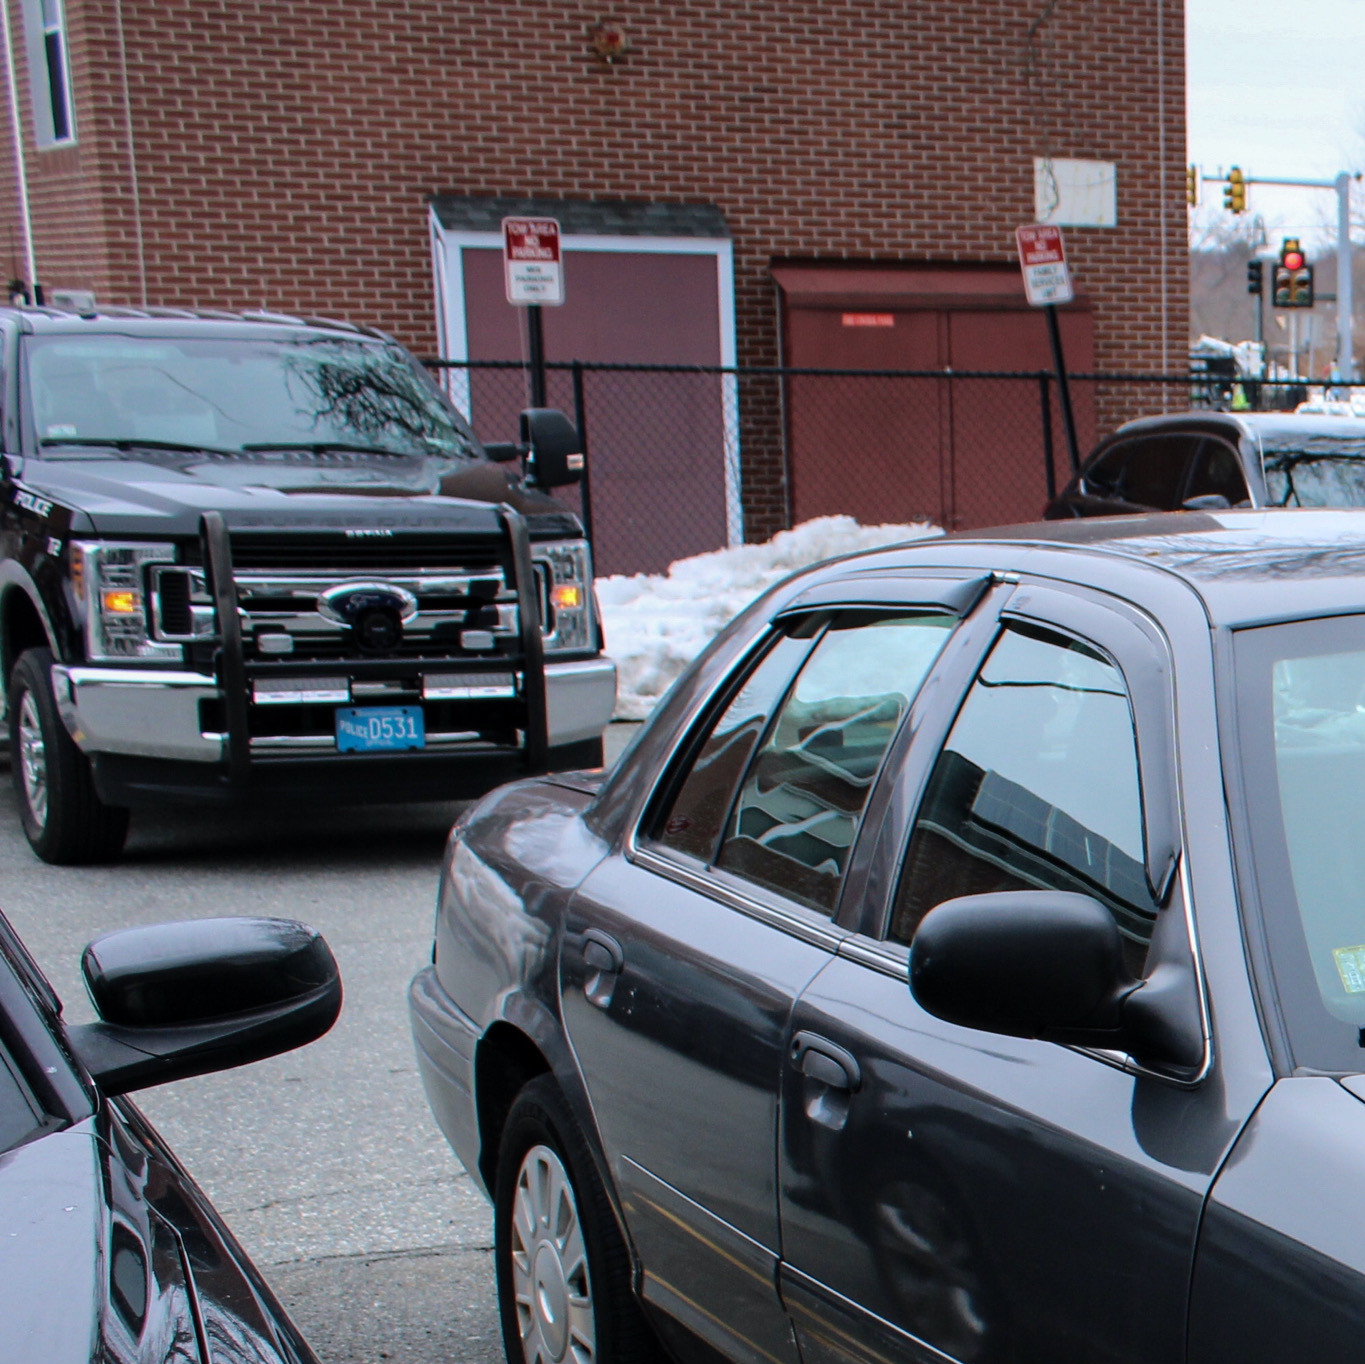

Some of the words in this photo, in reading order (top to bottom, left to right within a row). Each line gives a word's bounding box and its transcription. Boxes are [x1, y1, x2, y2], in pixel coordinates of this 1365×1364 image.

[507, 223, 528, 235] TOW
[529, 222, 556, 236] AREA
[524, 235, 540, 246] NO
[511, 246, 554, 259] PARKING
[13, 489, 54, 518] POLICE
[340, 719, 369, 739] POLICE
[368, 716, 419, 740] D531
